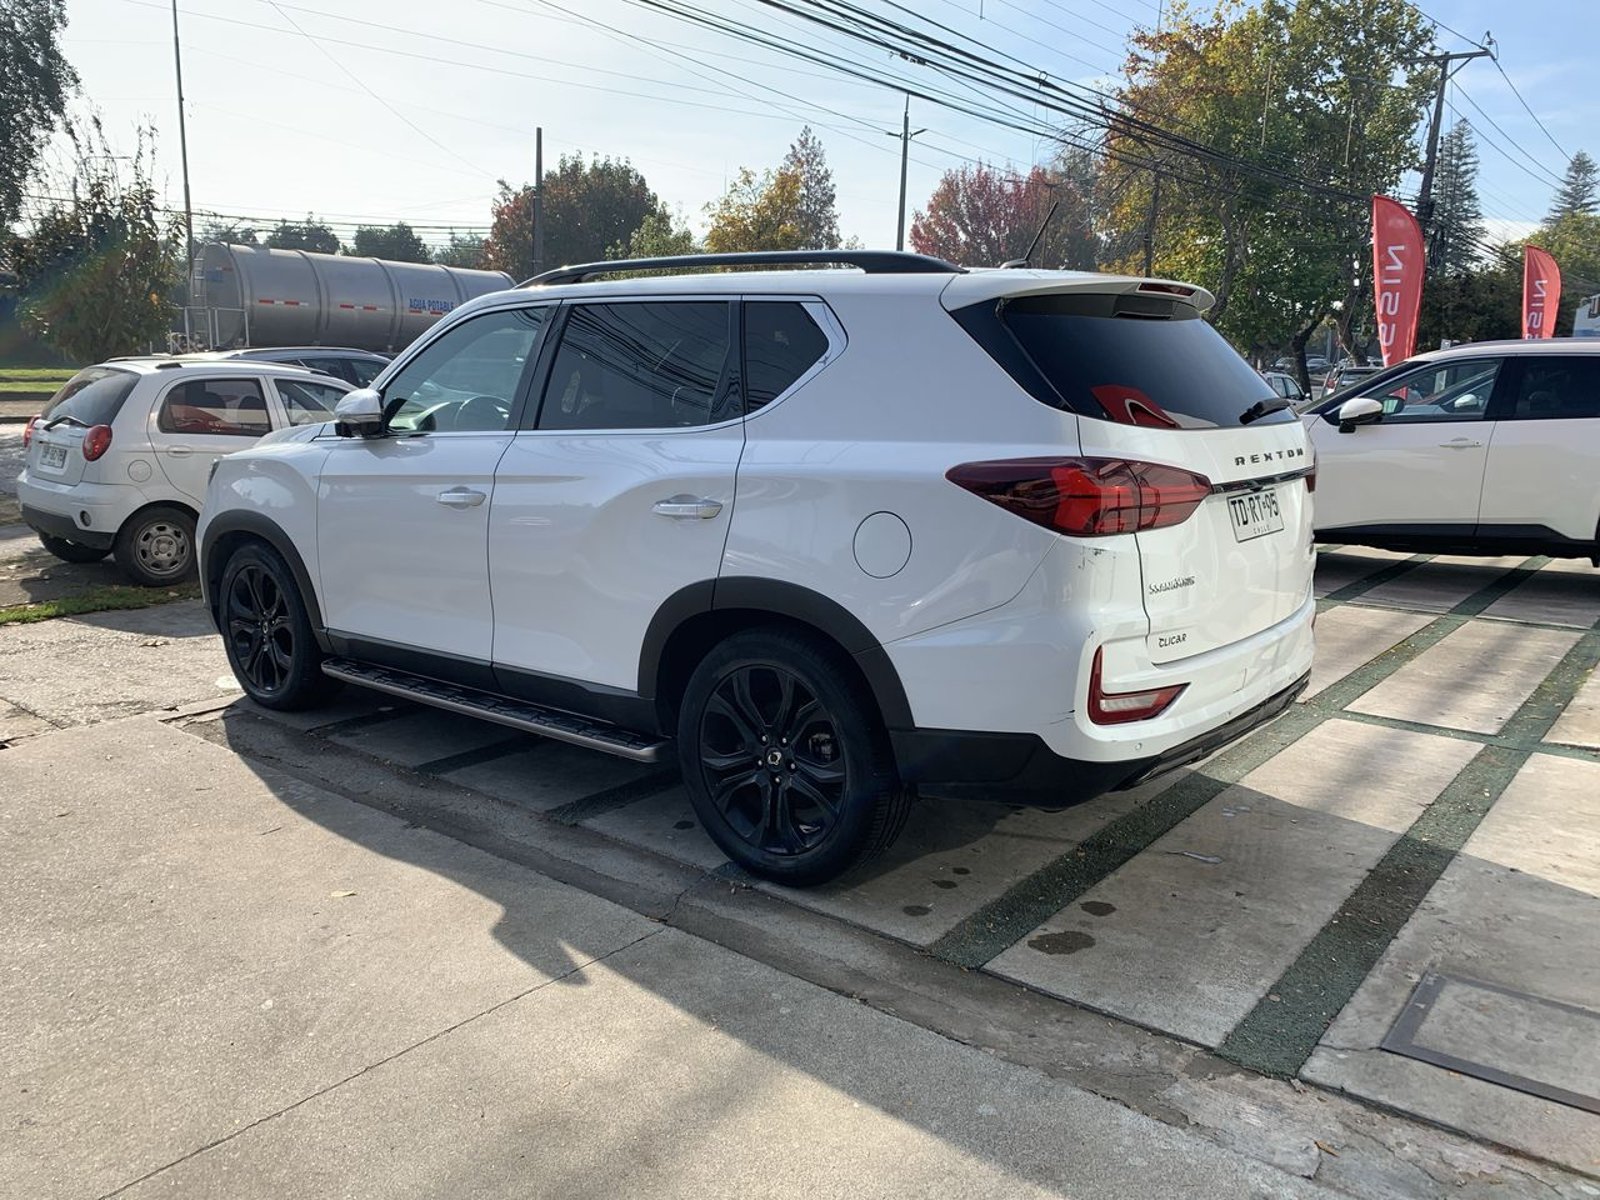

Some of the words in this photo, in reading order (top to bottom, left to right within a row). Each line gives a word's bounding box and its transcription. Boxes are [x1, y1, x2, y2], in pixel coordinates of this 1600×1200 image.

[409, 298, 426, 310] AGUA
[428, 300, 454, 312] POTABLE
[1234, 447, 1304, 466] REXTON
